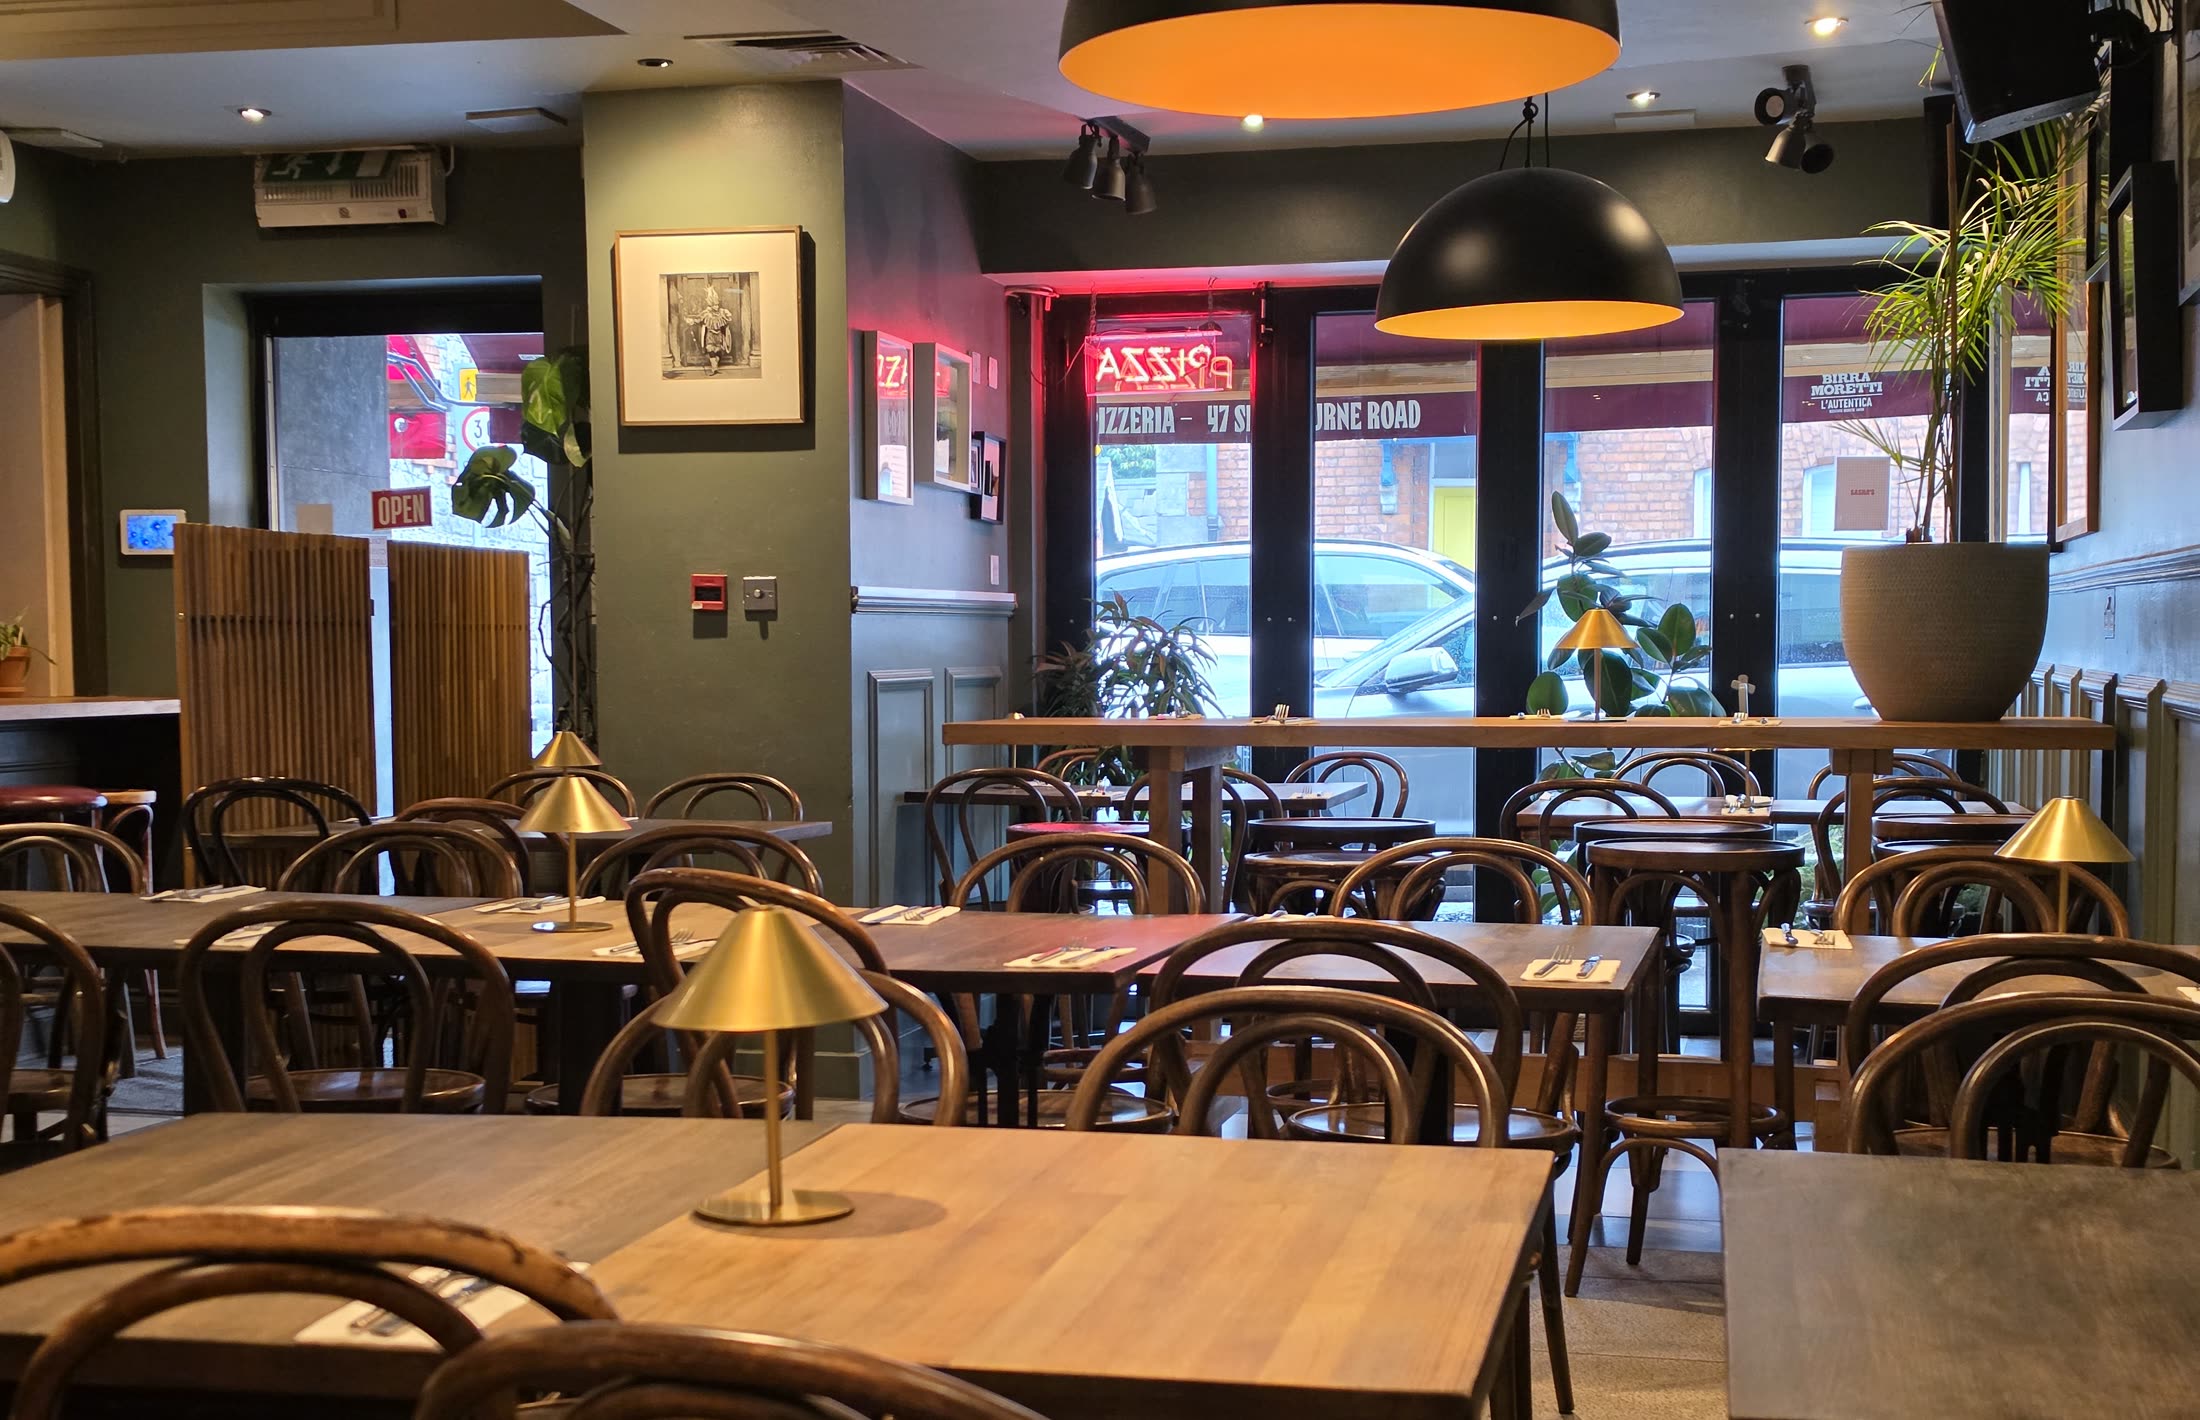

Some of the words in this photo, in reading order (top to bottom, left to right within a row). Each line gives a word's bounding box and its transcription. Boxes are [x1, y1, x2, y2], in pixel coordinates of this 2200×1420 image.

[1822, 372, 1871, 384] BIRRA
[1810, 382, 1883, 396] MORETTI
[1820, 397, 1873, 410] L'AUTENTICA
[1096, 406, 1176, 434] IZZERIA
[1207, 404, 1230, 433] 47
[1367, 399, 1421, 430] ROAD
[474, 419, 491, 439] 3
[378, 494, 425, 525] OPEN
